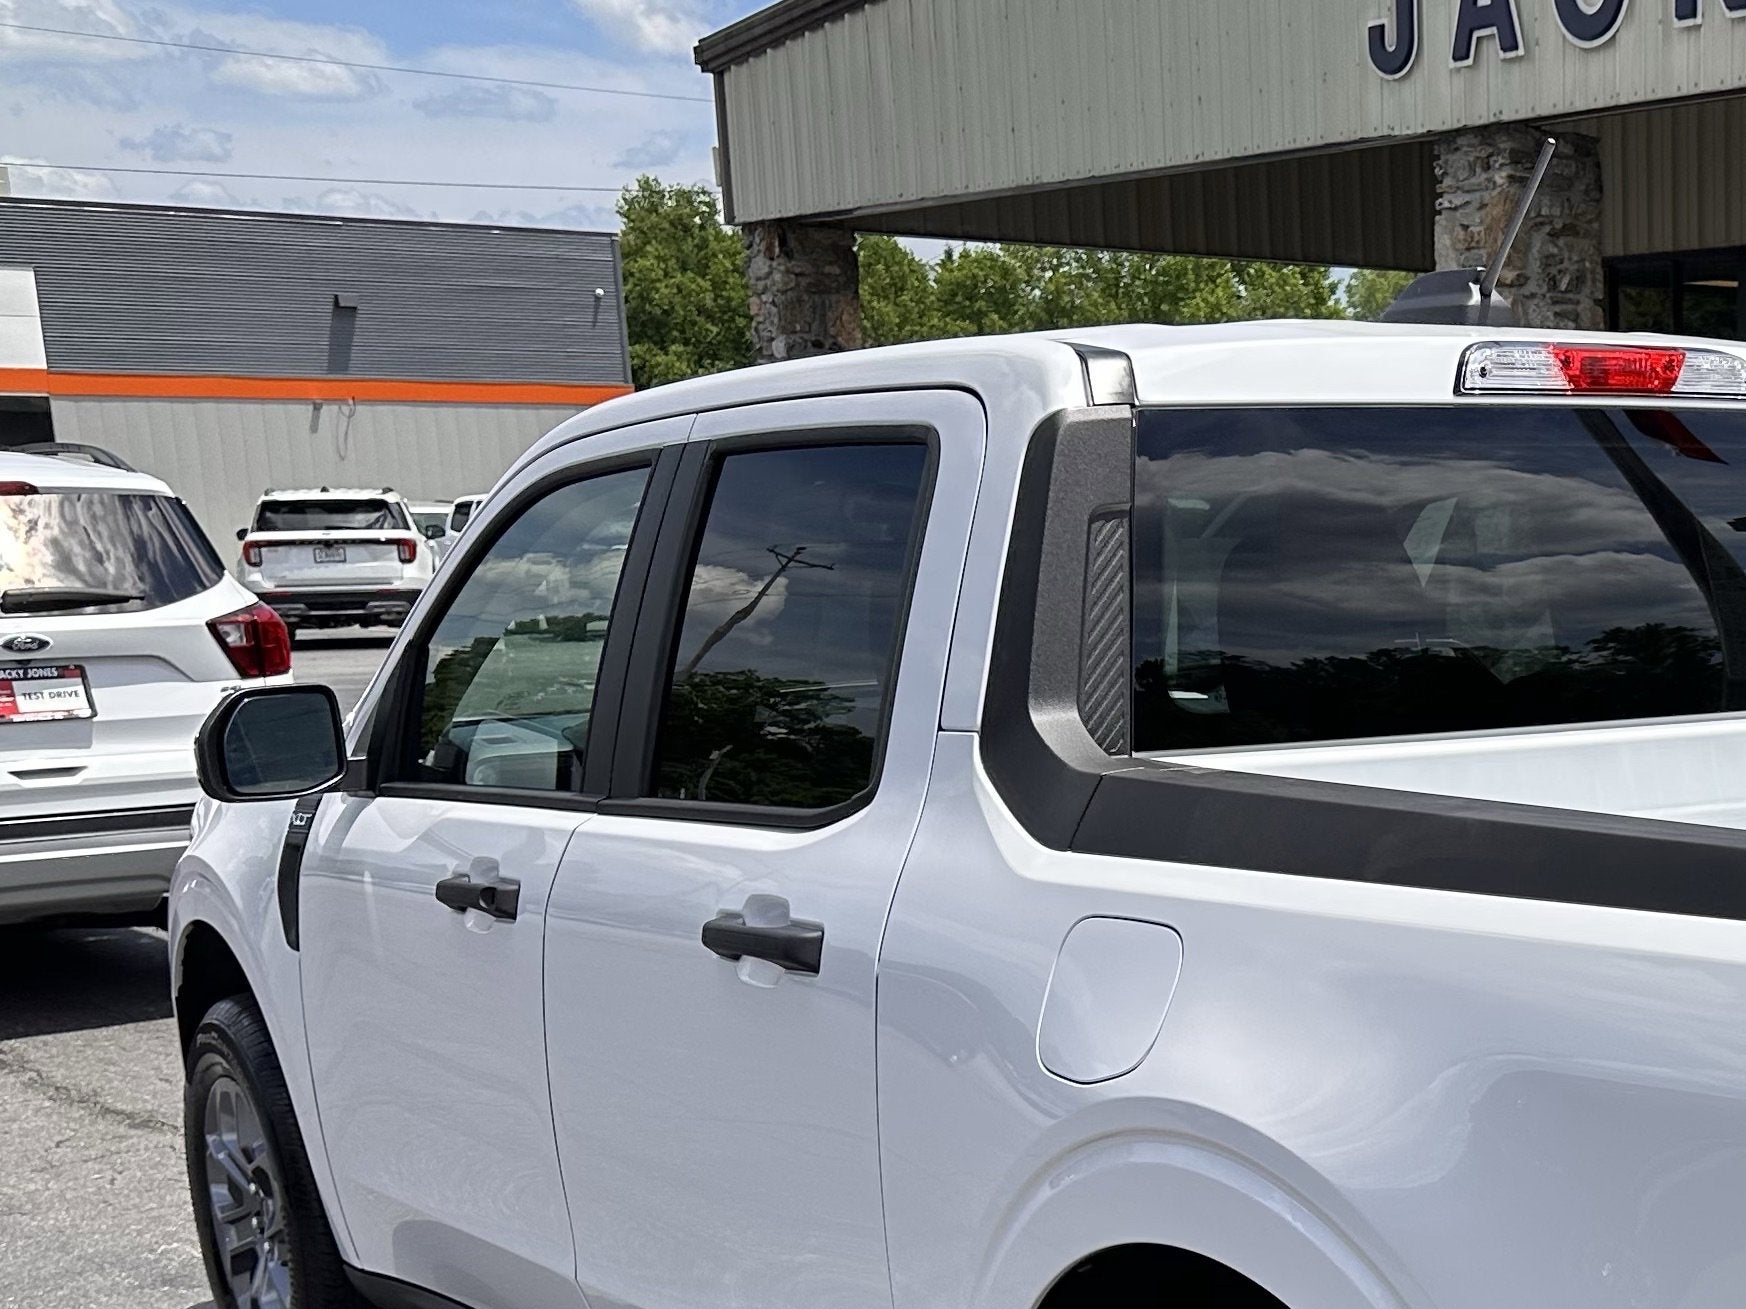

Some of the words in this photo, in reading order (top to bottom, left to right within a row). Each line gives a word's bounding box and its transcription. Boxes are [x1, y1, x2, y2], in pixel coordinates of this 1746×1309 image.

[0, 669, 24, 679] ACKY
[27, 667, 58, 678] JONES
[21, 692, 44, 701] TEST
[48, 689, 80, 699] DRIVE
